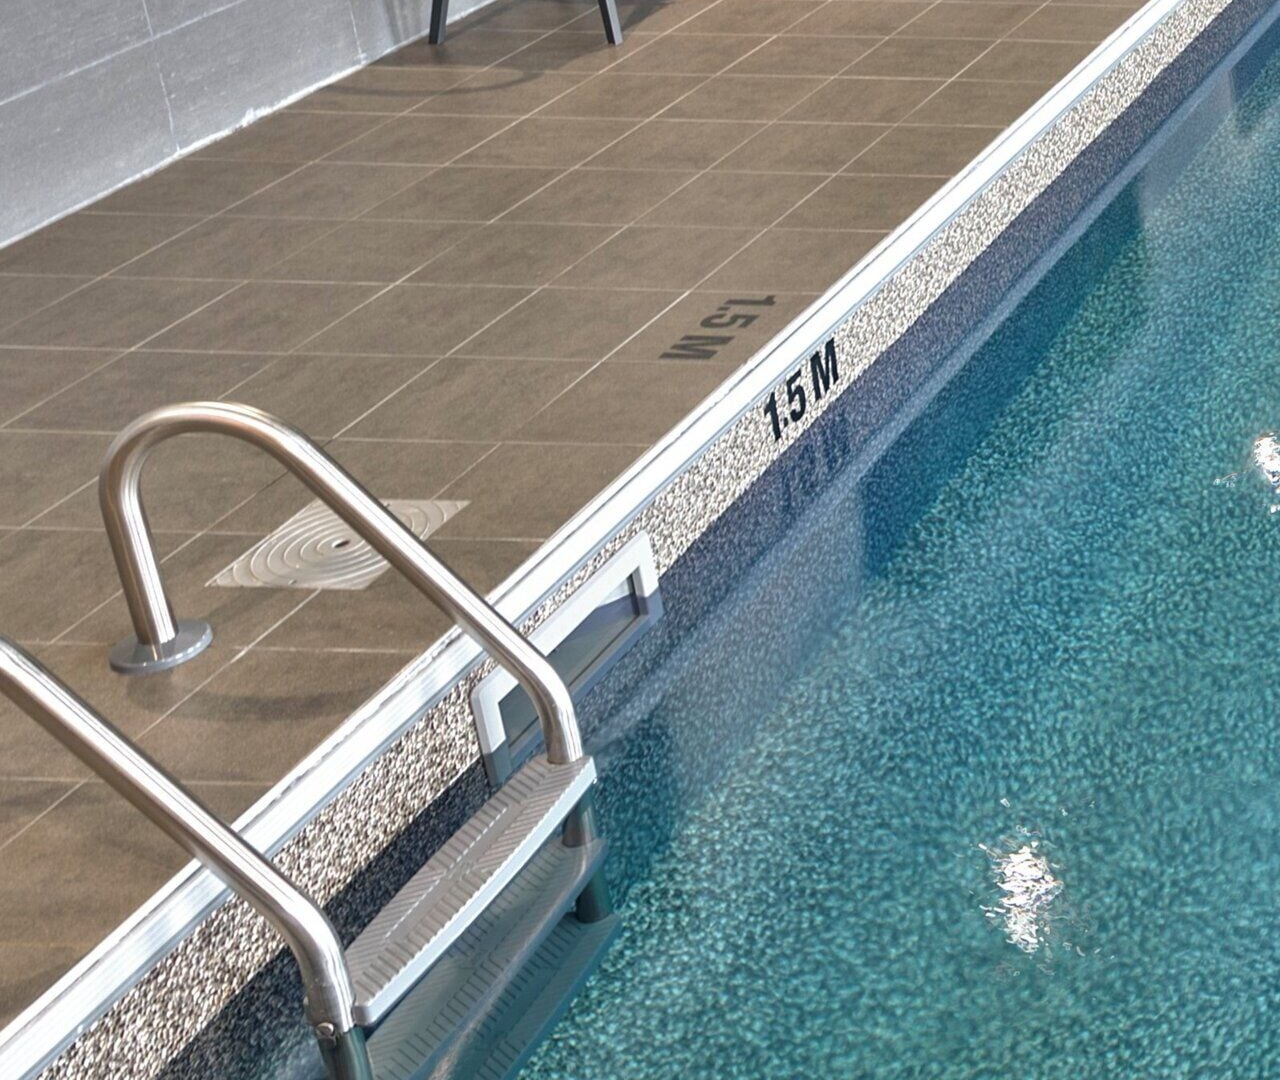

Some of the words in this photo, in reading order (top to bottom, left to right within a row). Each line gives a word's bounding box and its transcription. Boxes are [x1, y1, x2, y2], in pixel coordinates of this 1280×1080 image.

[700, 294, 776, 329] 1.5
[658, 335, 736, 360] M
[764, 369, 807, 442] 1.5
[810, 337, 839, 401] M
